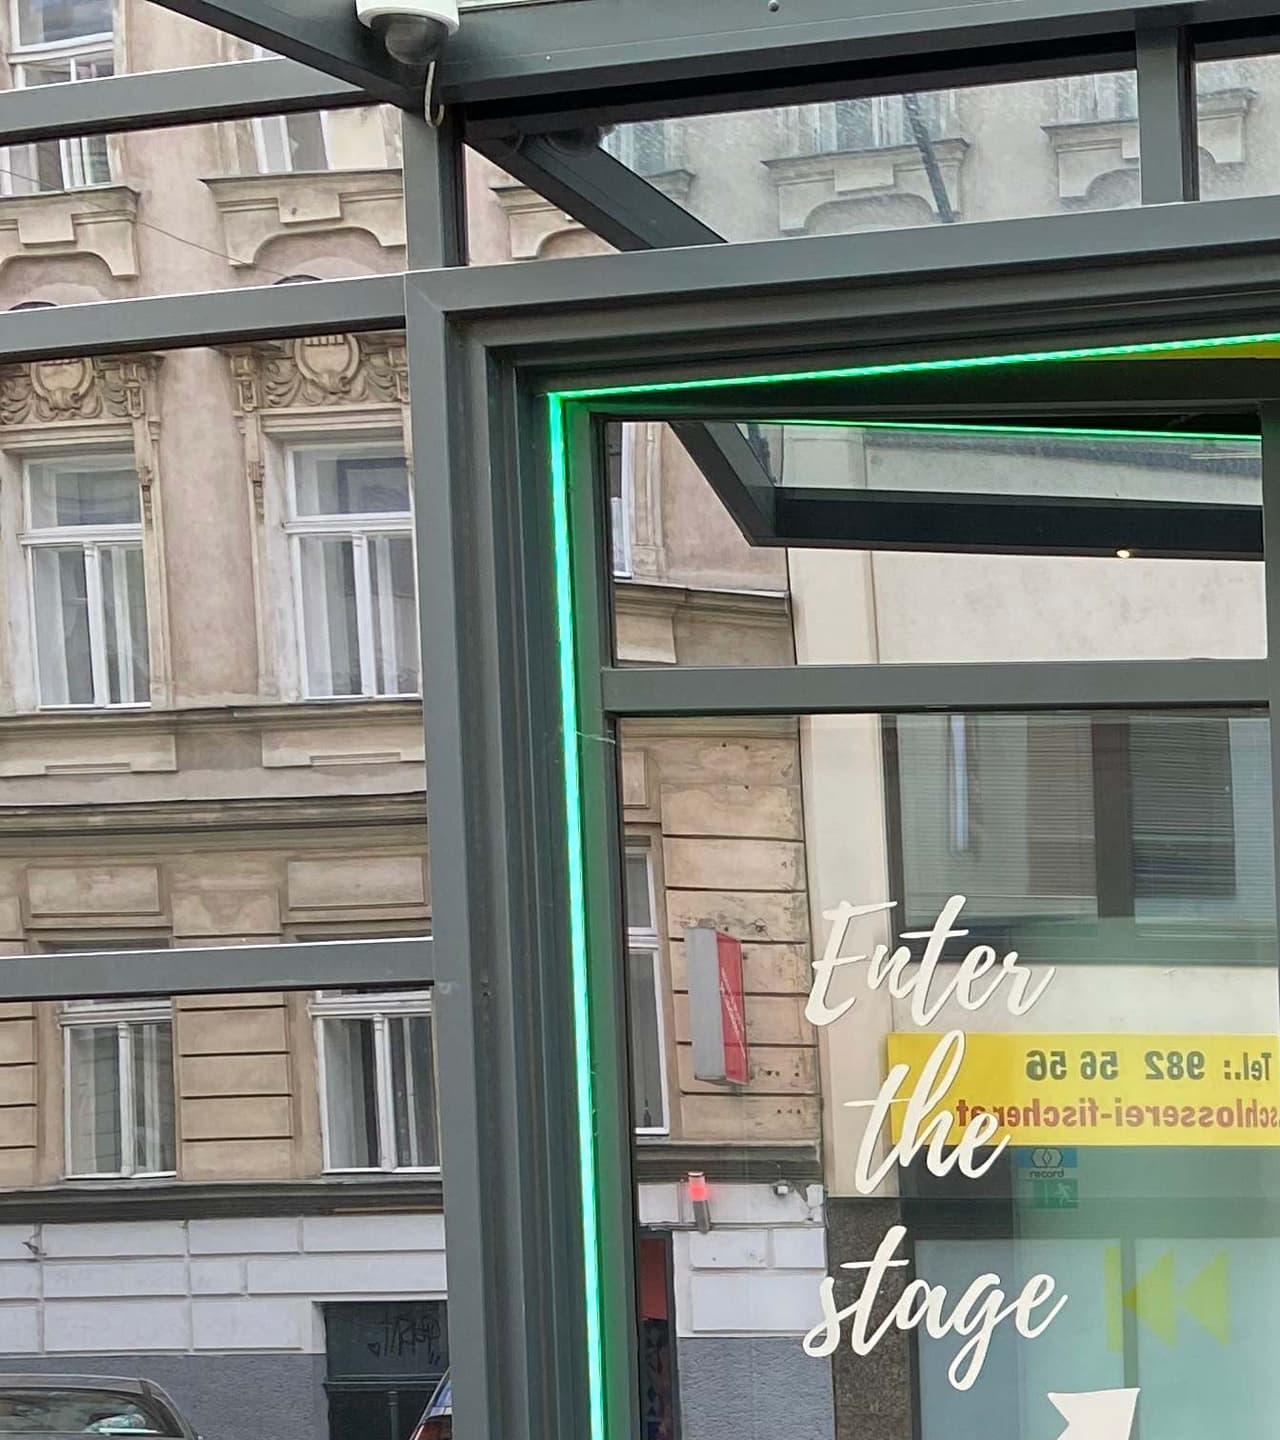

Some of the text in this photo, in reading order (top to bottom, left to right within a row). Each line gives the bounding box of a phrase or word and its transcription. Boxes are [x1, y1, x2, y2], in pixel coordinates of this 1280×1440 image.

[804, 895, 1056, 1026] Enter
[843, 1030, 1011, 1194] the
[802, 1225, 1068, 1391] stage
